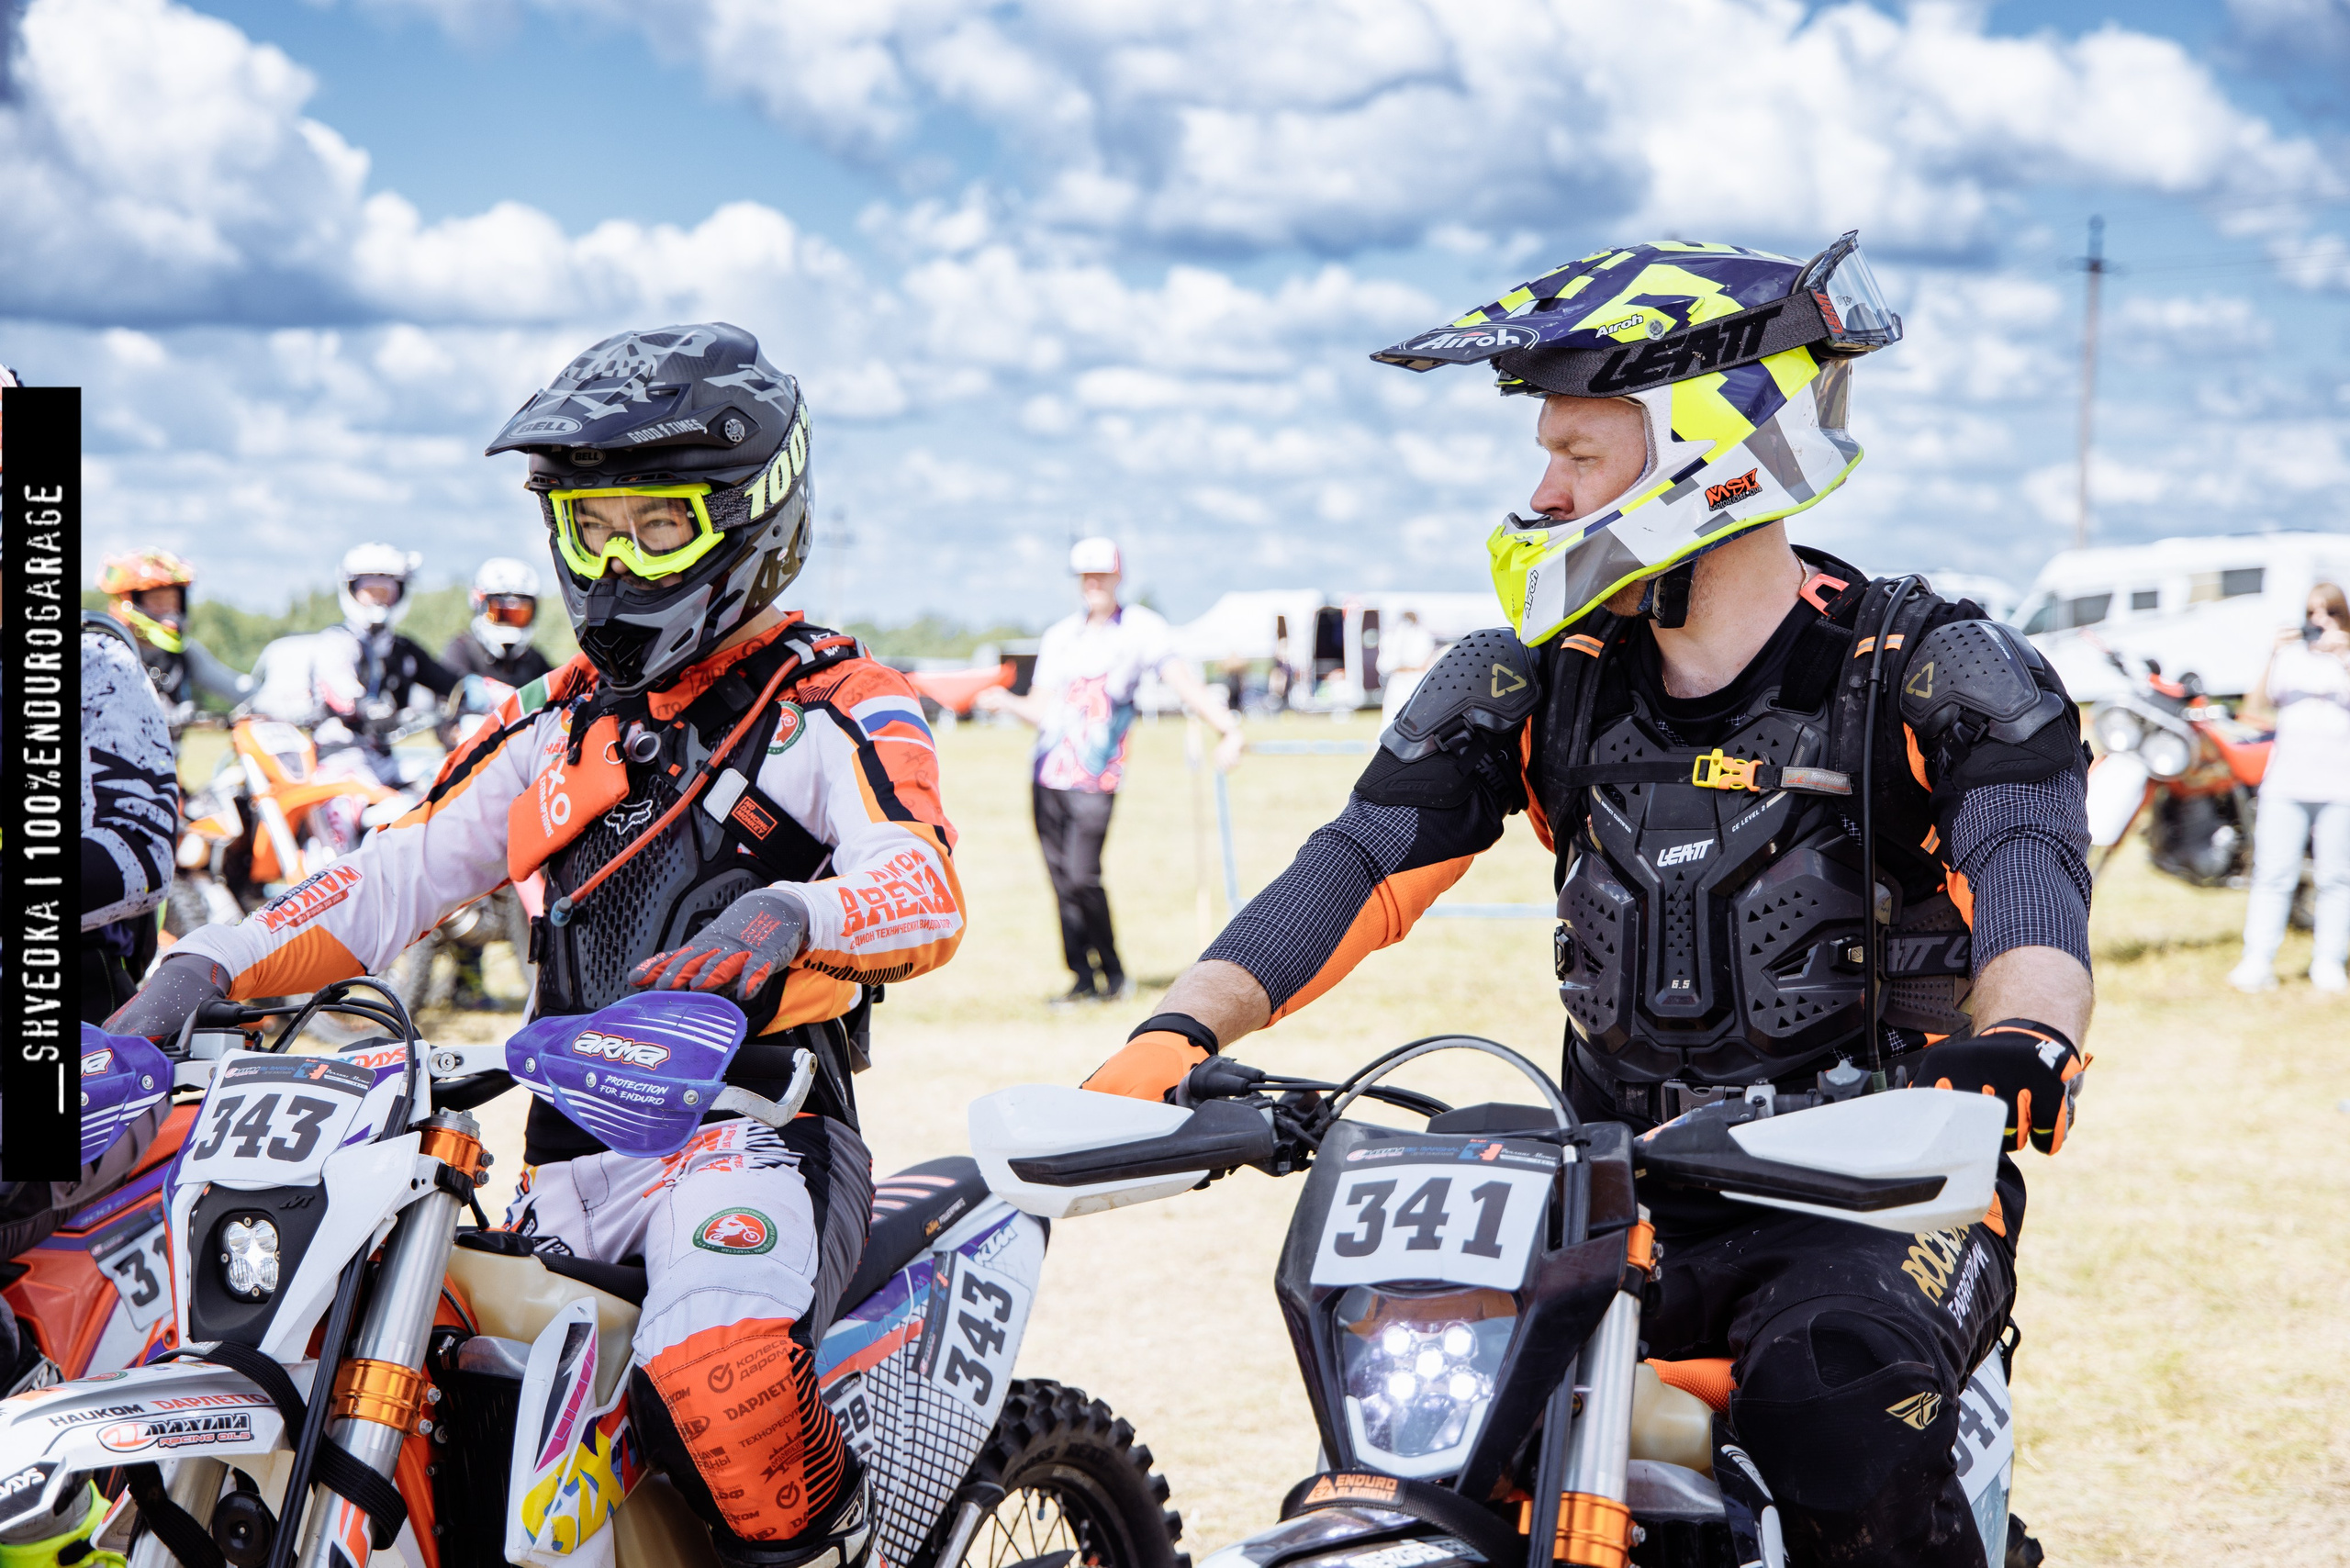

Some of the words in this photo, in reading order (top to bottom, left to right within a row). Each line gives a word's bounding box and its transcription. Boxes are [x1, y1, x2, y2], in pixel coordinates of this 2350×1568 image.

[1595, 315, 1643, 338] Airoh
[1414, 328, 1520, 351] Airoh
[1588, 305, 1781, 392] LEATT
[519, 421, 567, 433] BELL
[627, 429, 661, 444] GOOD
[575, 452, 600, 461] BELL
[1524, 569, 1539, 620] Airoh
[744, 800, 756, 811] NO
[1600, 801, 1614, 816] IMPACT
[735, 810, 766, 834] MONKEY
[1731, 822, 1740, 833] CE
[1740, 809, 1761, 825] LEVEL
[1657, 839, 1715, 868] LEATT
[838, 865, 957, 937] ARENA
[599, 1084, 618, 1097] FOR
[619, 1091, 666, 1105] ENDURO
[605, 1074, 669, 1095] PROTECTION
[193, 1093, 339, 1163] 343
[1333, 1177, 1514, 1260] 341
[944, 1271, 1013, 1406] 343
[735, 1338, 789, 1369] колеса
[739, 1347, 789, 1382] даром
[144, 1415, 250, 1436] MAXIMA
[217, 1431, 251, 1442] OILS
[1334, 1473, 1399, 1489] ENDURO
[1335, 1486, 1396, 1502] ELEMENT
